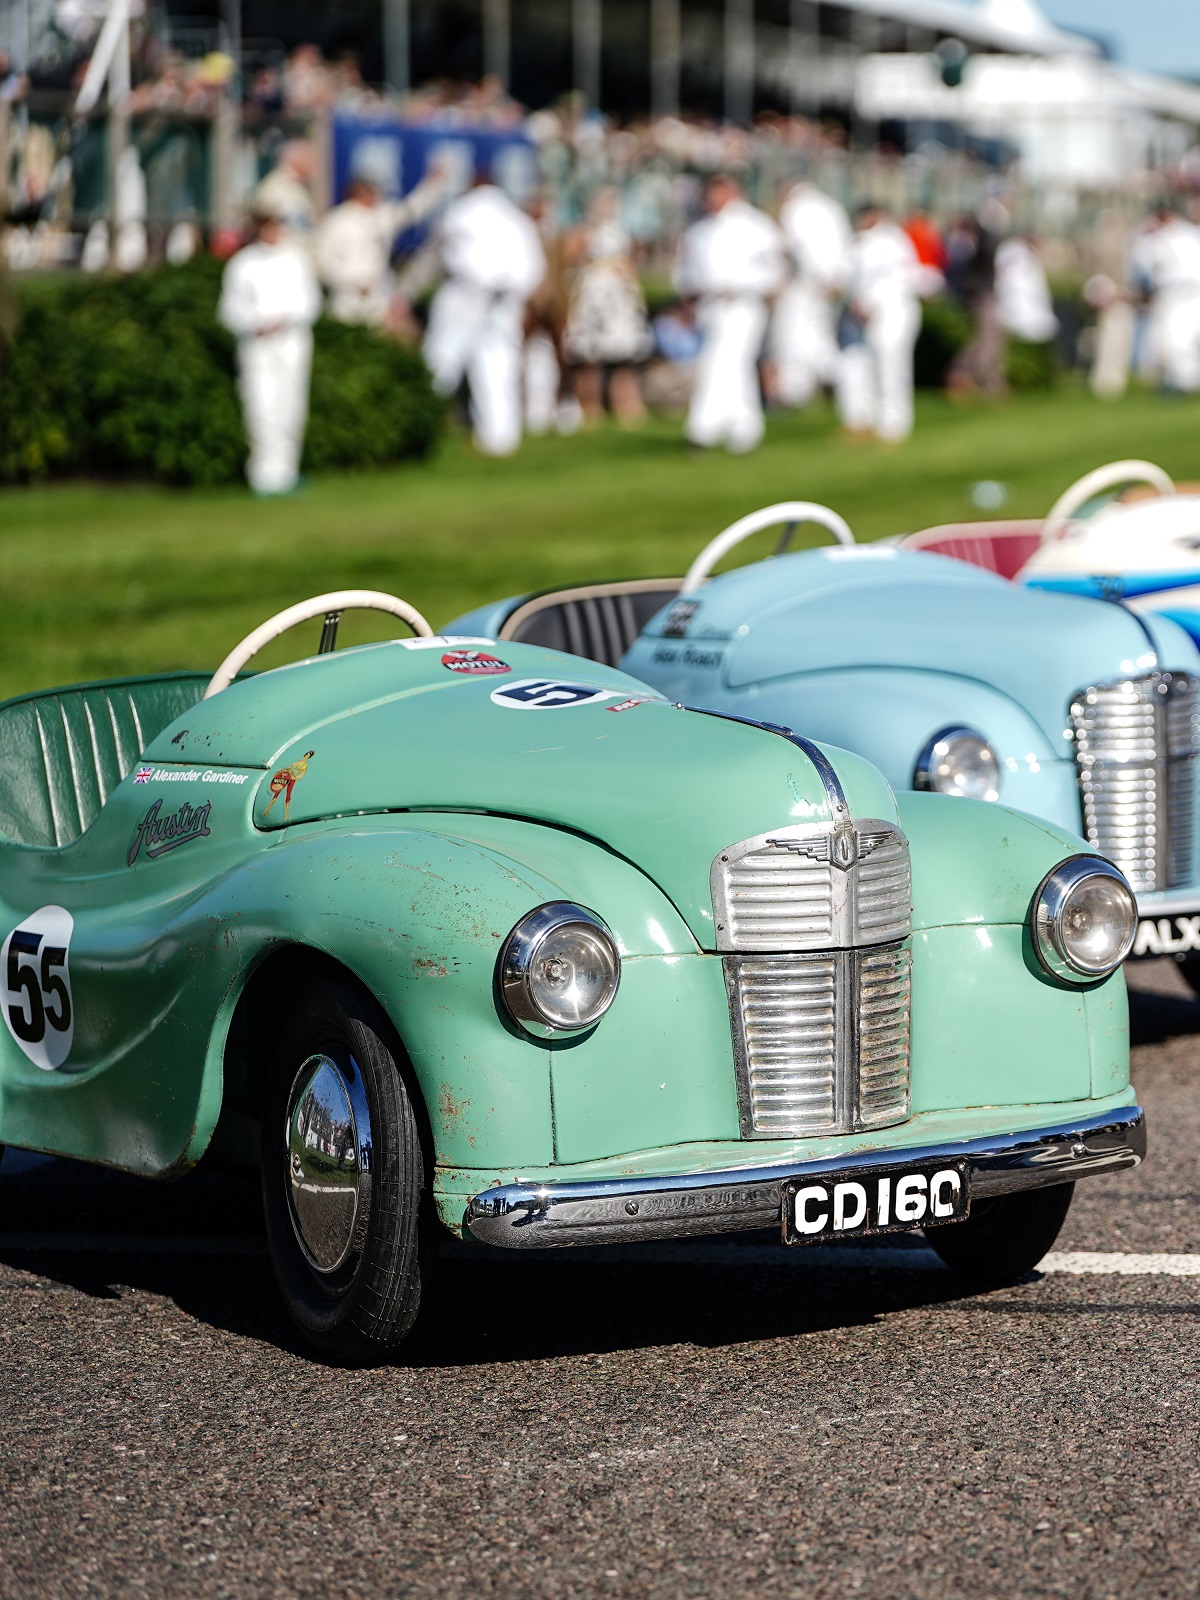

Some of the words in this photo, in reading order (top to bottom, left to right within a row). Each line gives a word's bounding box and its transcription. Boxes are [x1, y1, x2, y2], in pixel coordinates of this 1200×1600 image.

[446, 660, 506, 671] MOTUL
[151, 769, 202, 783] Alexander
[202, 770, 249, 785] Gardiner
[128, 798, 213, 868] Austin
[7, 930, 71, 1043] 55
